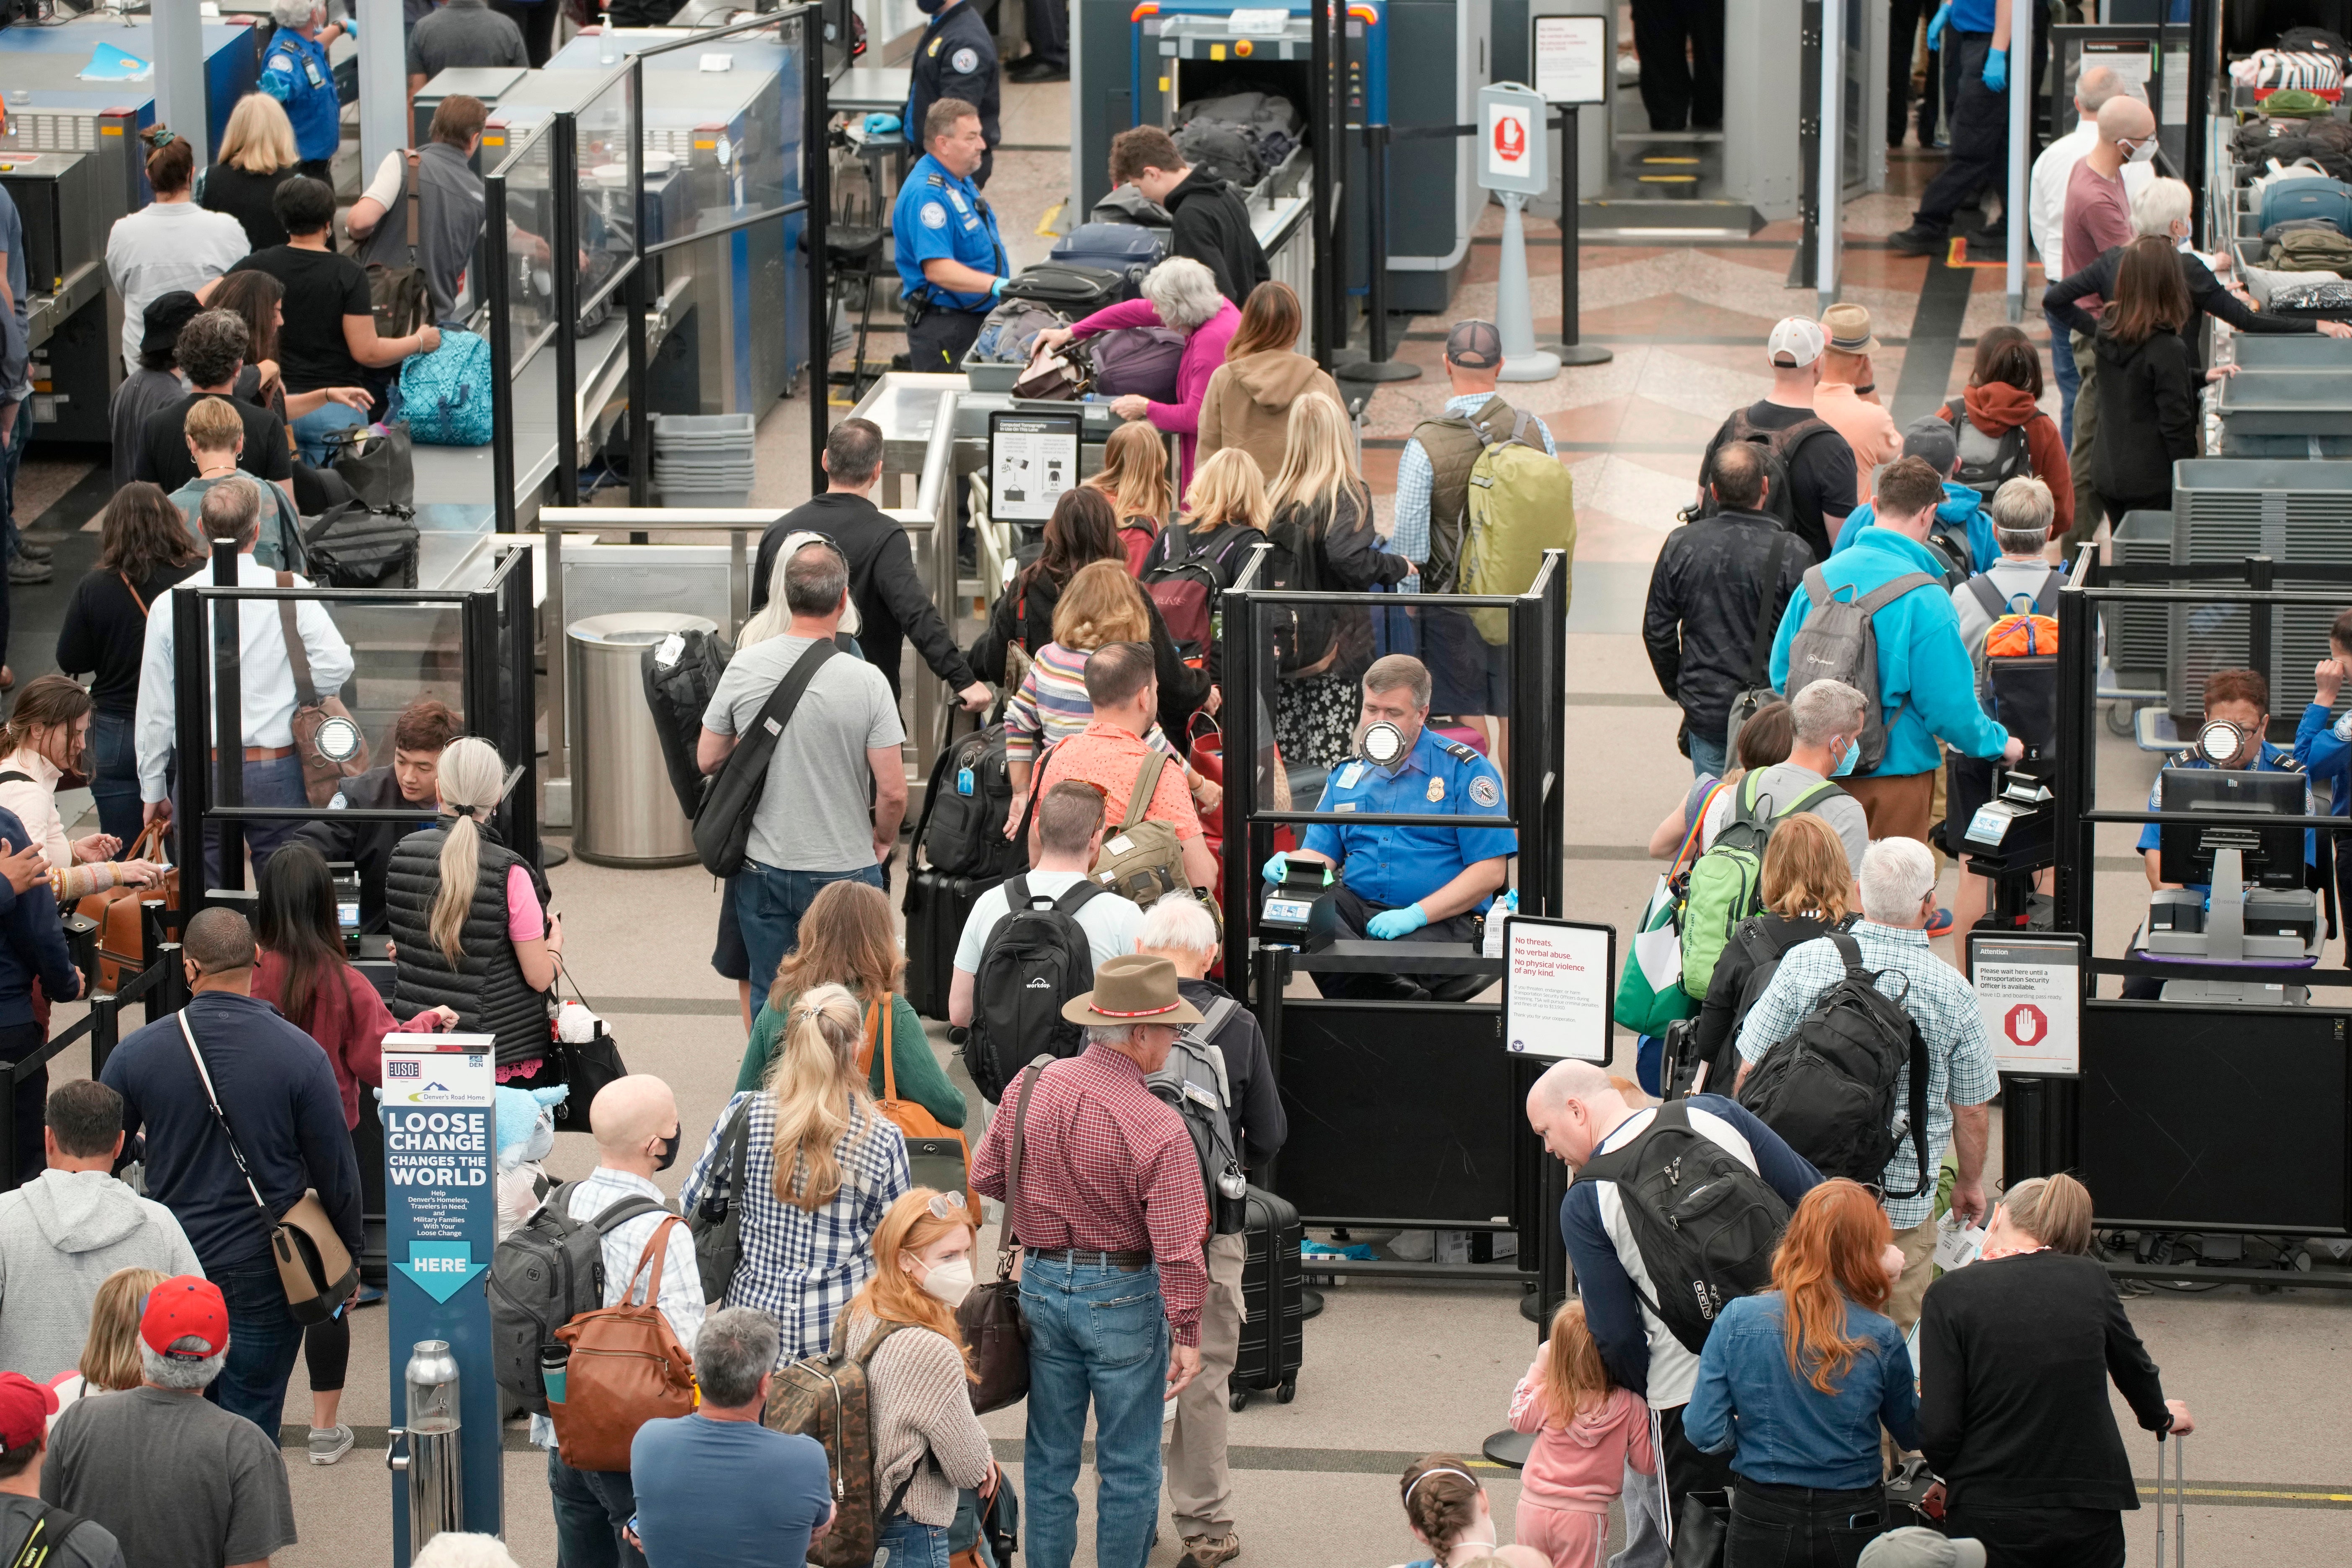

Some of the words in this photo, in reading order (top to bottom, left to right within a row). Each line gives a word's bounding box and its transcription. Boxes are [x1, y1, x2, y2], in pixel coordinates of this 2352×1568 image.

[2179, 750, 2189, 762] TSA
[2282, 758, 2296, 768] TSA
[1527, 938, 1553, 947] threats.
[1550, 951, 1572, 959] abuse.
[1526, 960, 1554, 968] physical
[1556, 962, 1585, 972] violence
[1538, 969, 1555, 977] kind.
[395, 1063, 414, 1076] USO
[389, 1112, 485, 1133] LOOSE
[389, 1133, 485, 1151] CHANGE
[389, 1155, 455, 1166] CHANGES
[459, 1156, 486, 1167] THE
[389, 1168, 487, 1186] WORLD
[414, 1258, 466, 1272] HERE
[1693, 1280, 1714, 1320] OGIO
